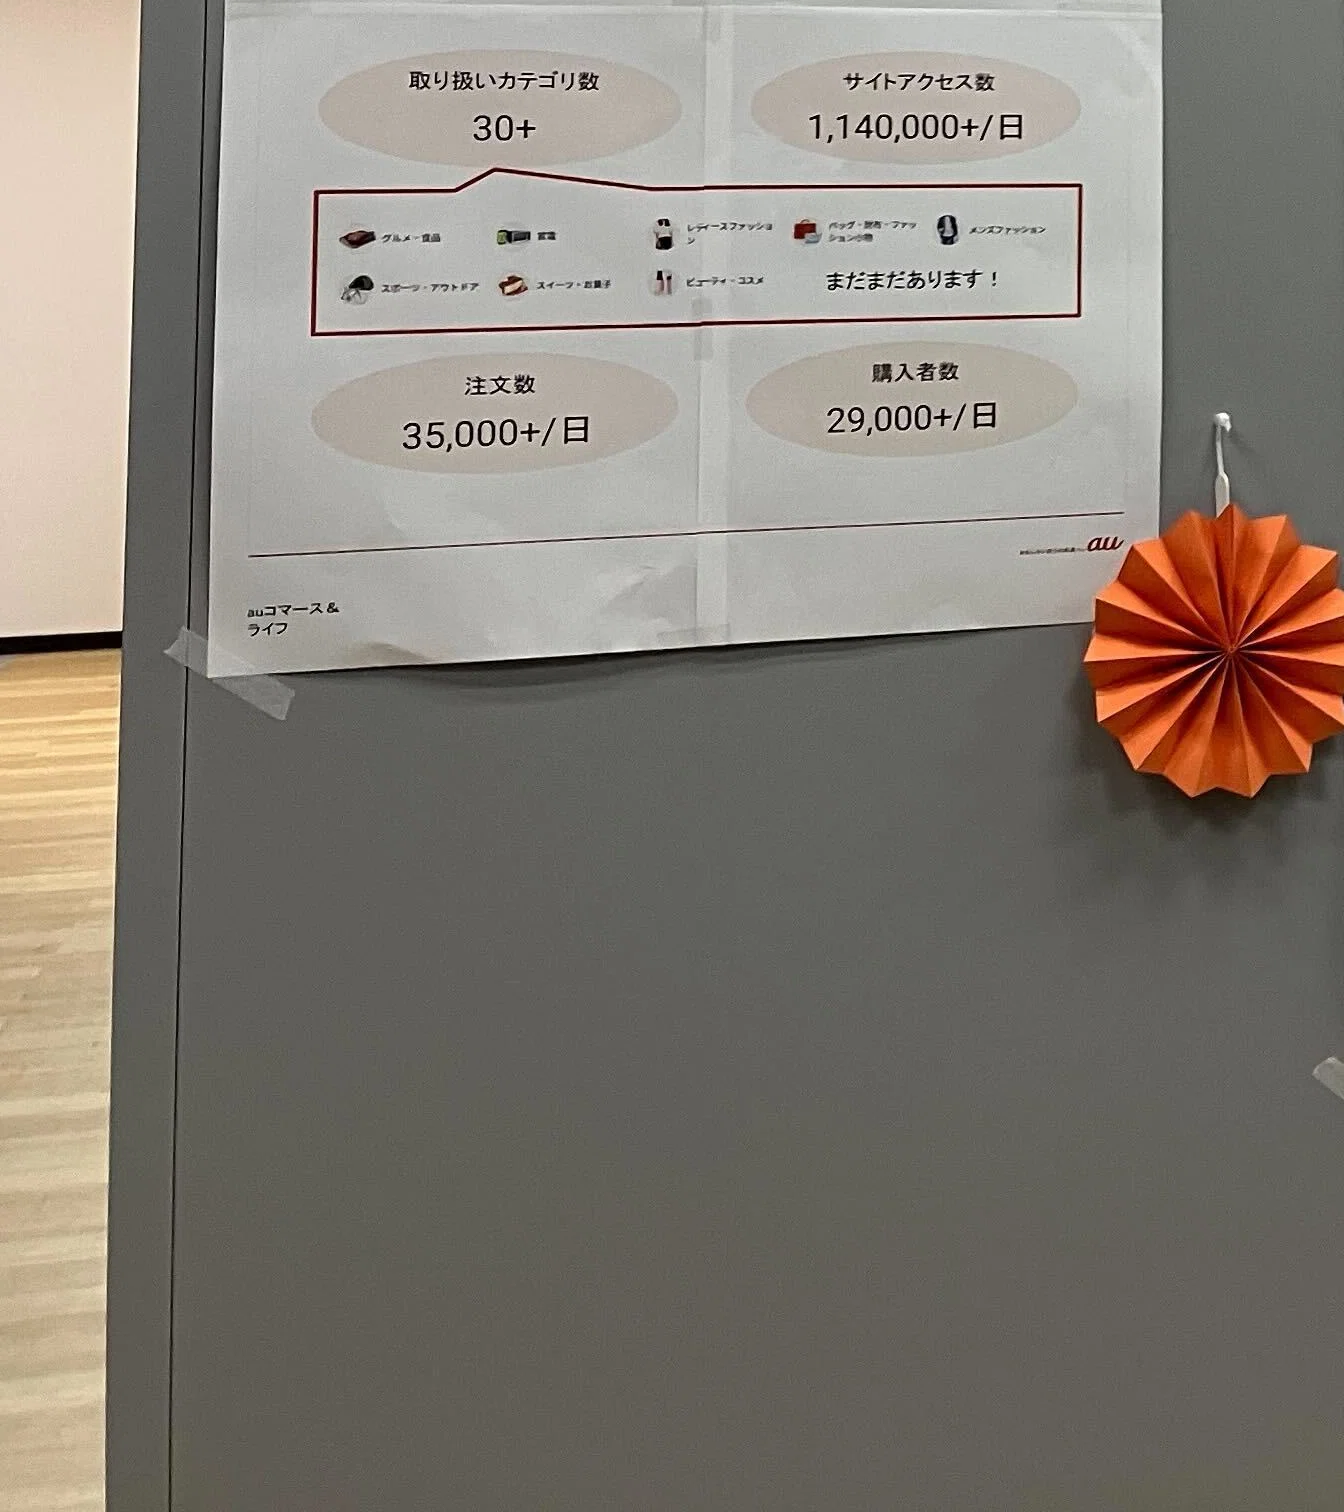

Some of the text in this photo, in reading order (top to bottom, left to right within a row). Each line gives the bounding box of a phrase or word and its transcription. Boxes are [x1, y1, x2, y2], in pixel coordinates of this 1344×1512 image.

[409, 70, 599, 92] 取り扱いカテゴリ数
[843, 71, 995, 92] サイトアクセス数
[472, 114, 537, 142] 30+
[871, 361, 960, 384] 購入者数
[464, 373, 537, 397] 注文数
[1088, 536, 1124, 551] au
[247, 622, 288, 637] ライフ
